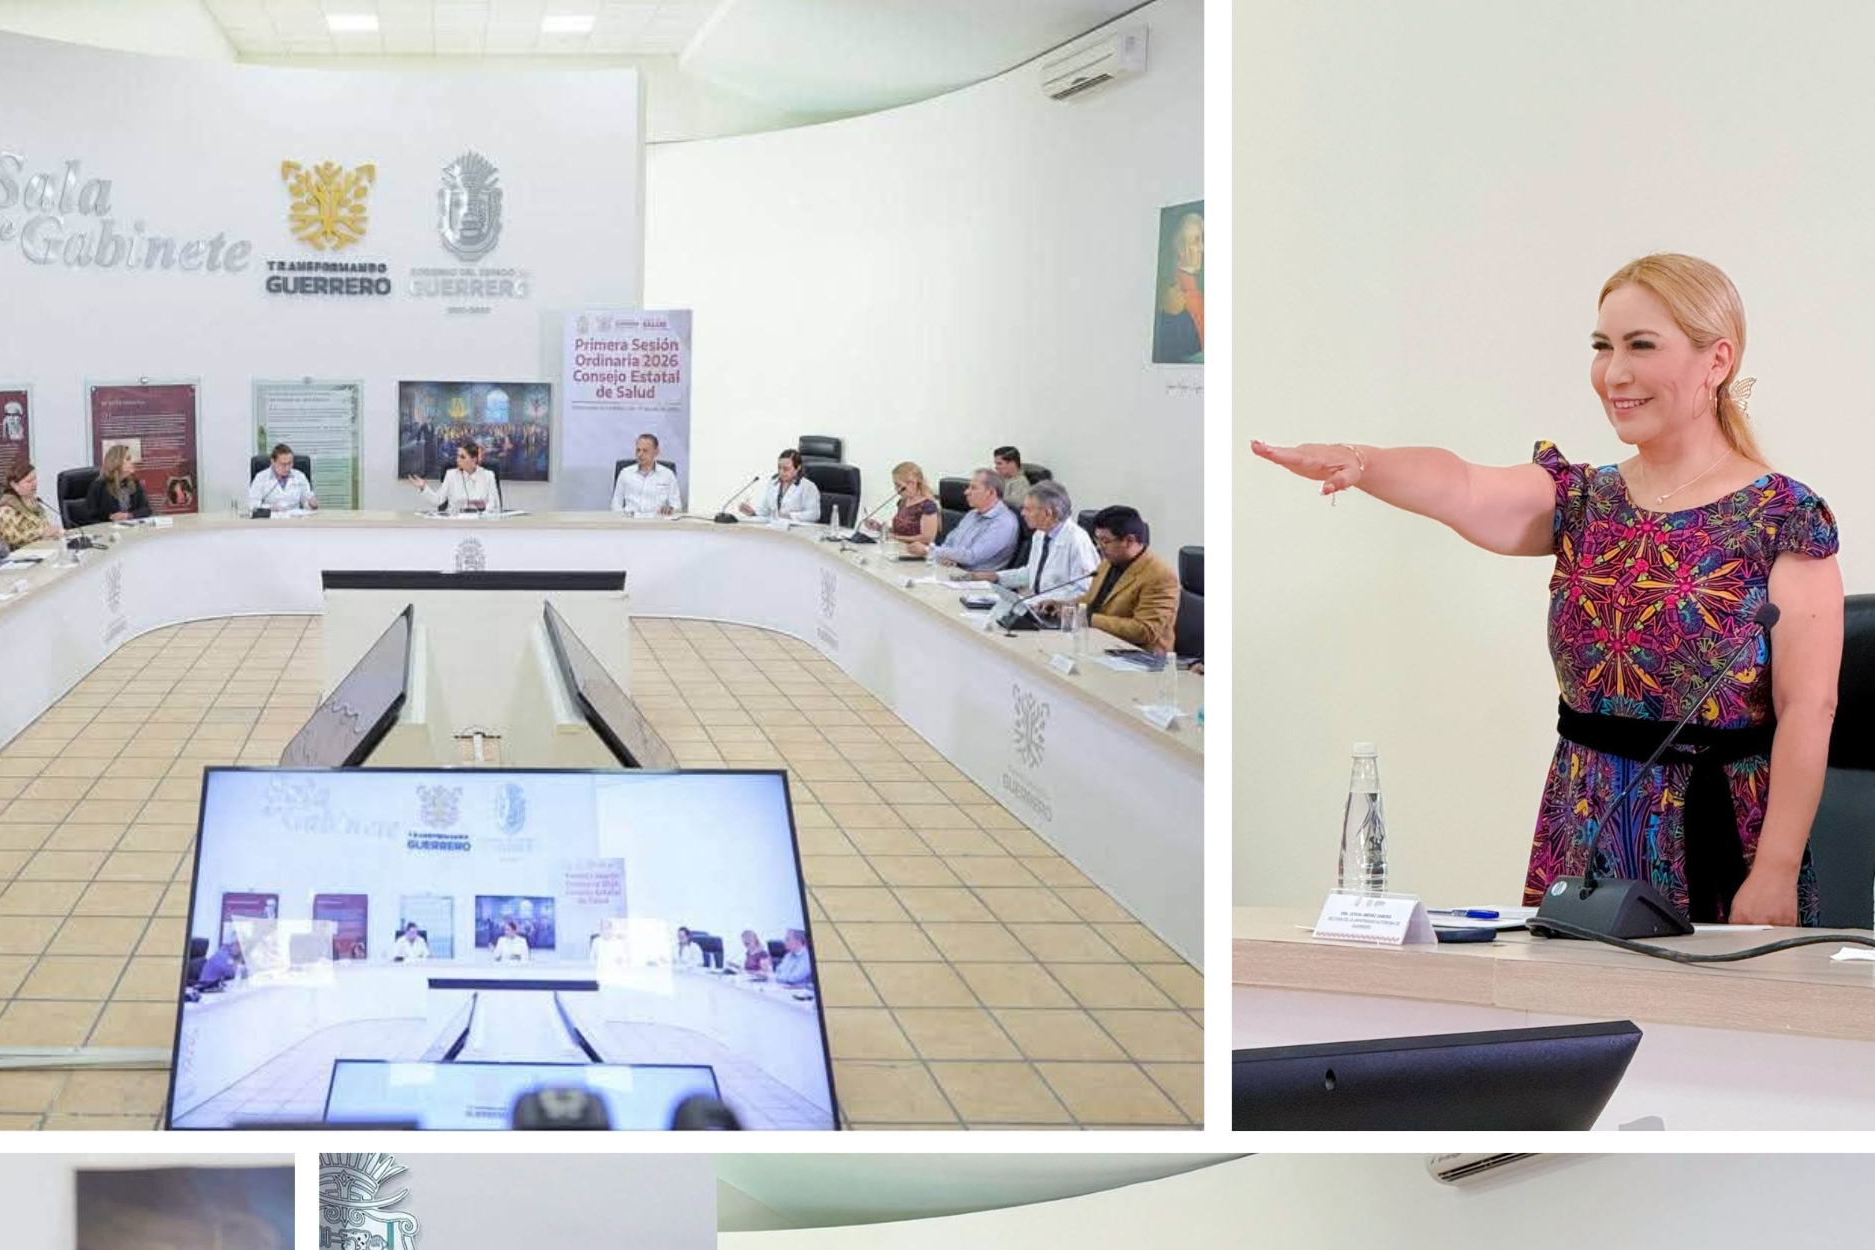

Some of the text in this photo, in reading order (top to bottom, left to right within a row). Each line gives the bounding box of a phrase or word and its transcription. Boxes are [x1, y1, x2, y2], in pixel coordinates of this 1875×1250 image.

[20, 214, 252, 273] Gabinete
[266, 276, 391, 296] GUERRERO
[575, 337, 679, 351] Primera Sesión
[575, 354, 679, 367] Ordinaria 2026
[573, 370, 680, 385] Consejo Estatal
[596, 386, 655, 399] de Salud
